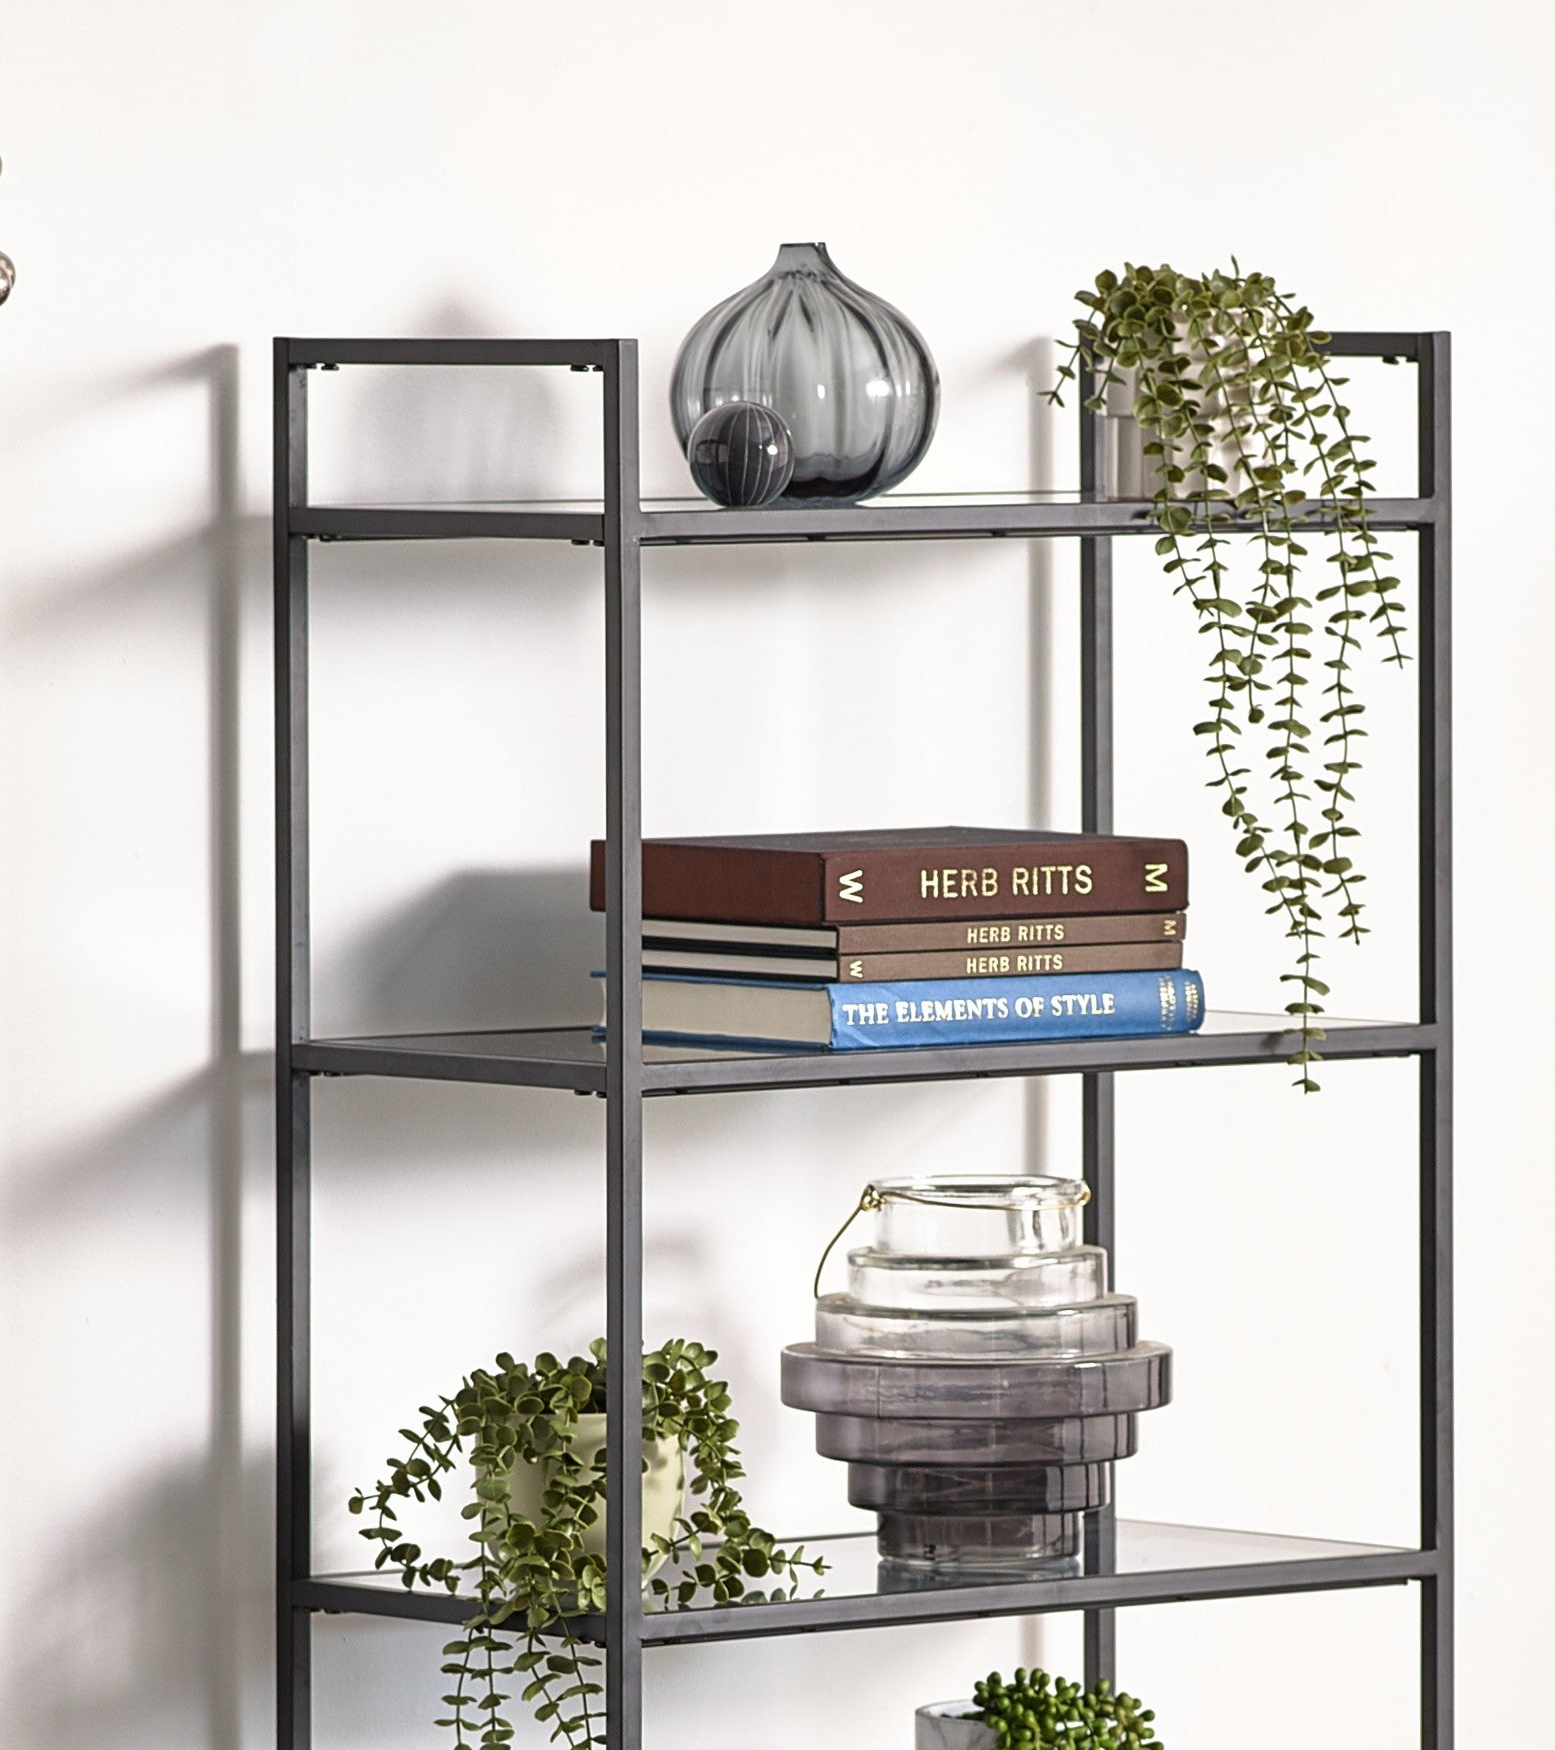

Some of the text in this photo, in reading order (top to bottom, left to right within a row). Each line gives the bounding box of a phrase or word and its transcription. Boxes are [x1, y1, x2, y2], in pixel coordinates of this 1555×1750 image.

[920, 864, 1094, 899] HERB RITTS
[1143, 863, 1169, 893] M
[965, 924, 1065, 944] HERB RITTS
[965, 953, 1064, 974] HERB RITTS
[841, 992, 1117, 1026] THE ELEMENTS OF STYLE
